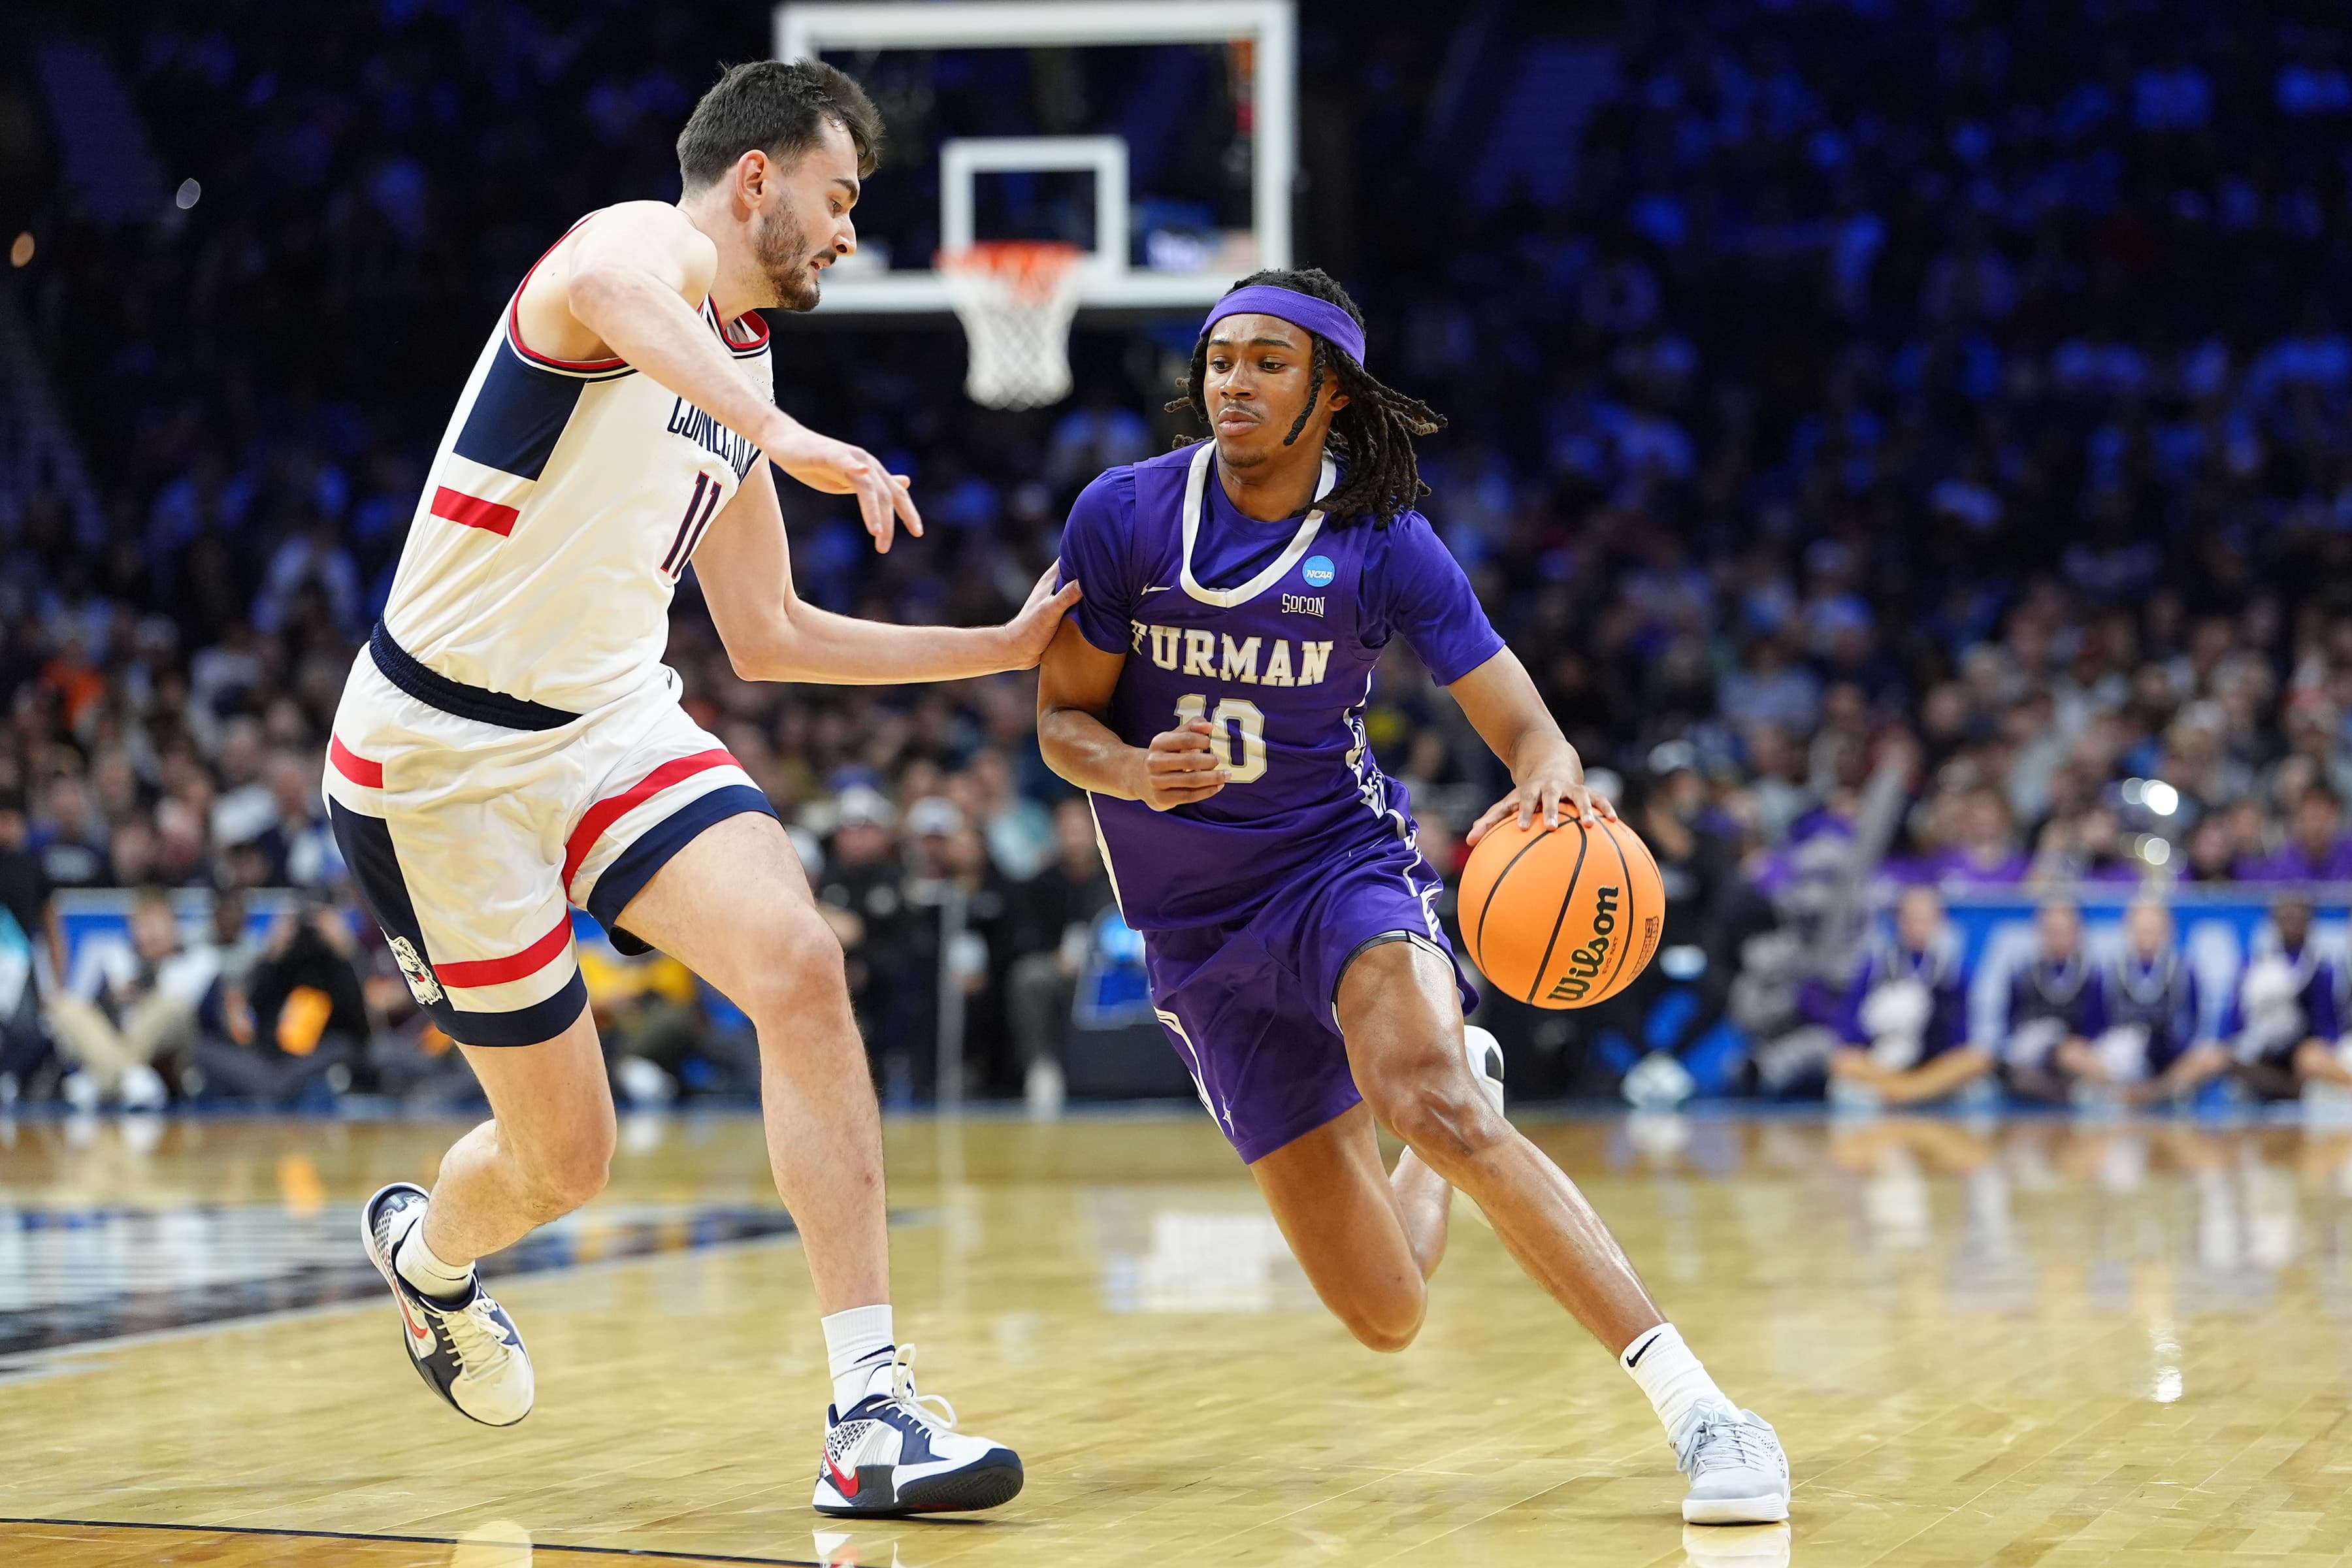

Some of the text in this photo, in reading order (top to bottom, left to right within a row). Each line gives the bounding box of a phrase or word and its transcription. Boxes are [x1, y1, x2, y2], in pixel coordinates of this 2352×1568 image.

[660, 470, 722, 580] 11
[1281, 593, 1326, 618] SOCON
[1306, 569, 1333, 580] NCAA
[1130, 619, 1333, 687] FURMAN
[1546, 885, 1619, 1002] Wilson
